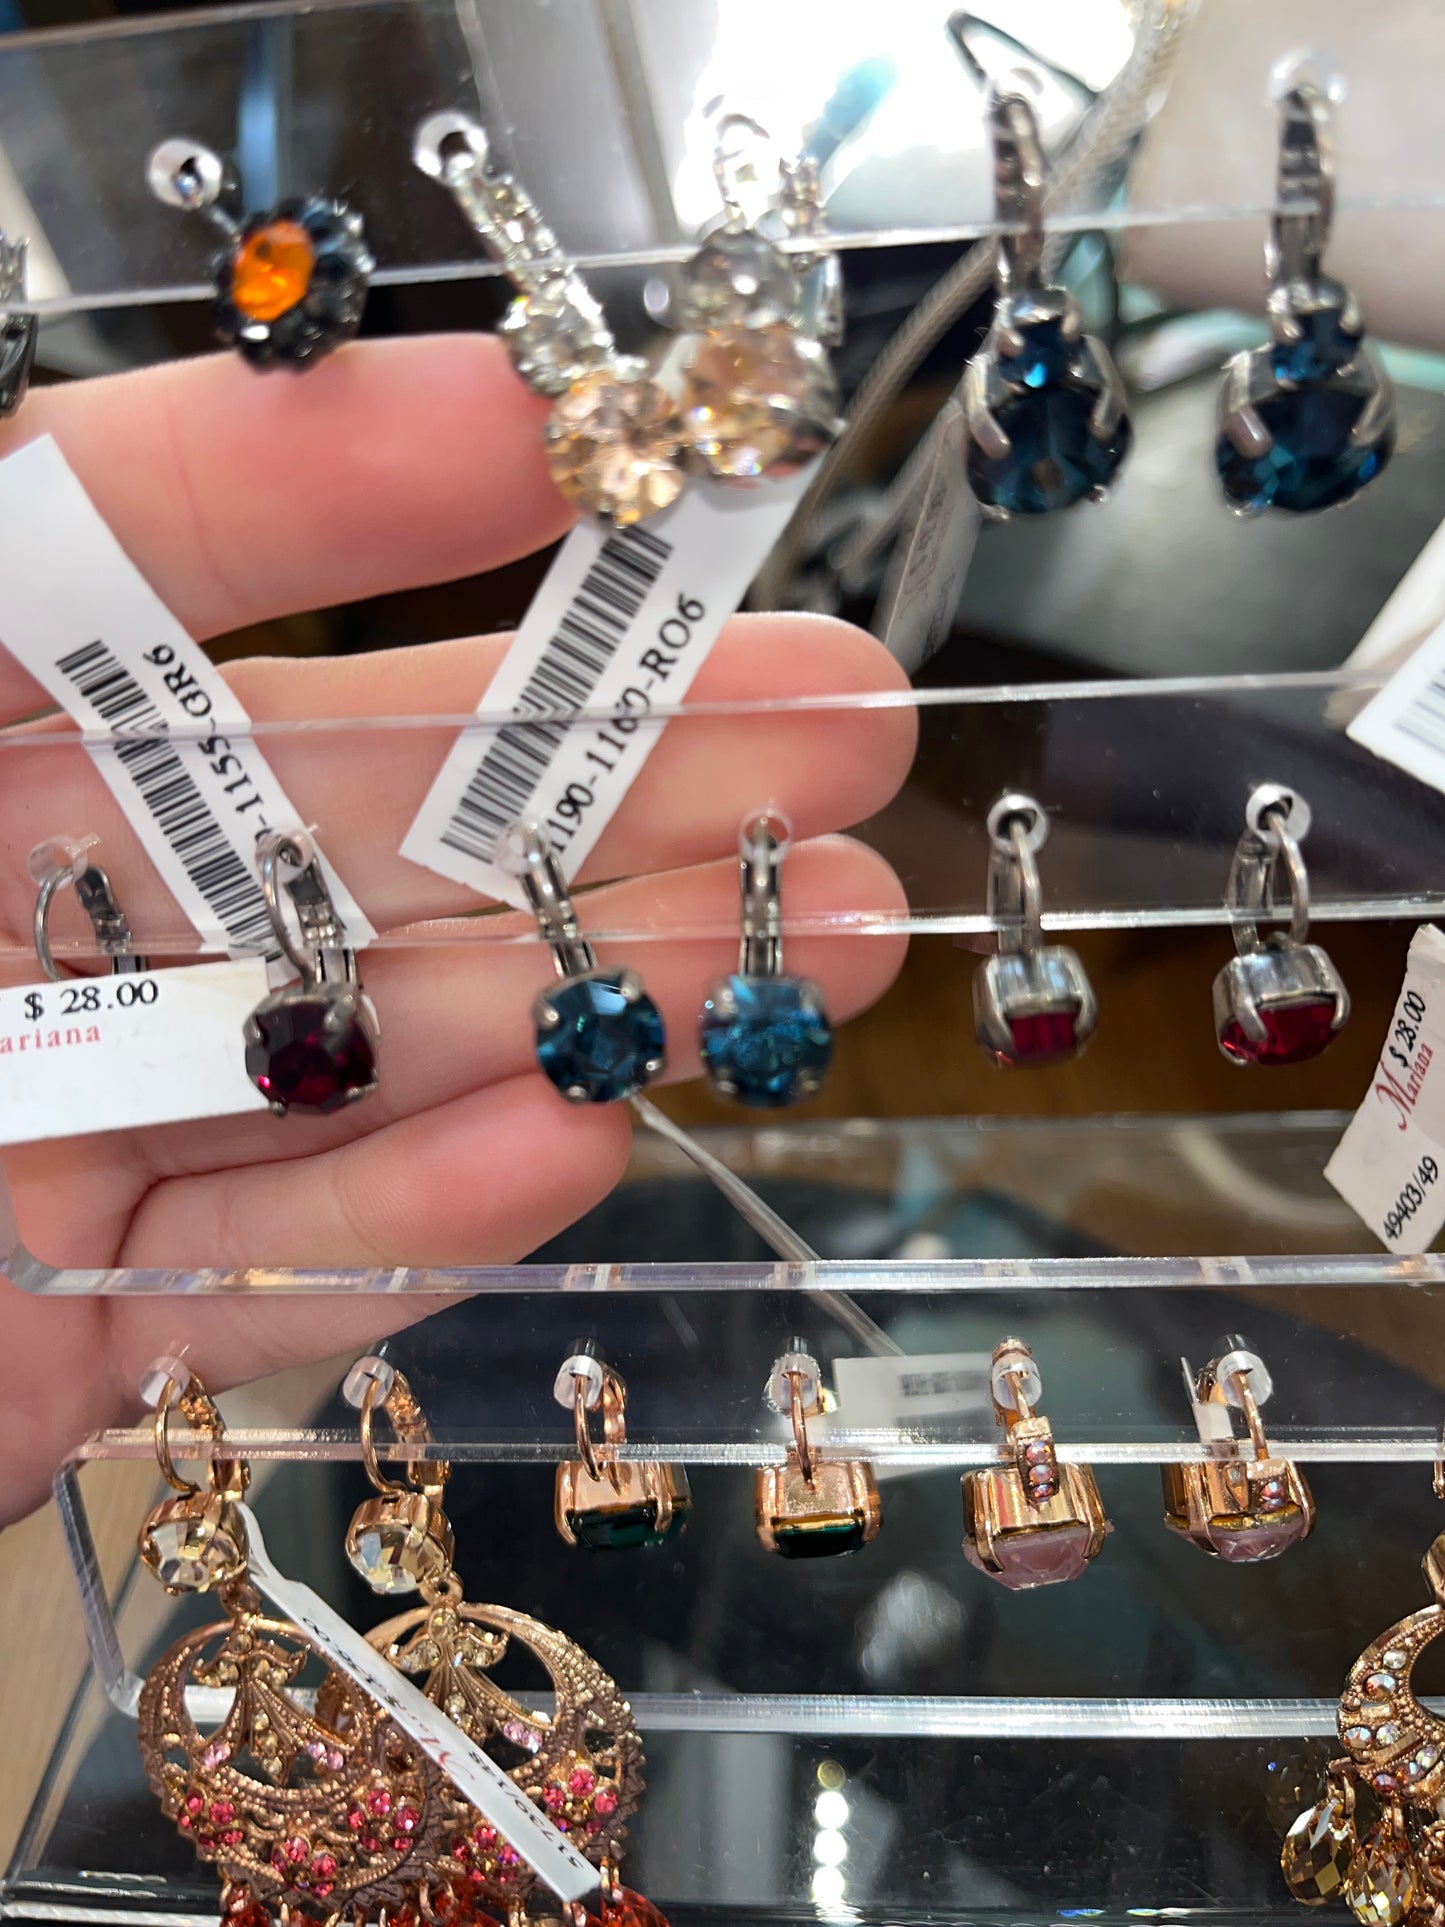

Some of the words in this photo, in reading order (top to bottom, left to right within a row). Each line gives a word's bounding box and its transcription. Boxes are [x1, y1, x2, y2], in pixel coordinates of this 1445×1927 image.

[142, 644, 274, 842] -1155-GR6
[24, 992, 45, 1021] $
[60, 980, 159, 1015] 28.00
[1394, 990, 1427, 1053] 28.00
[0, 1026, 101, 1055] ariana
[1388, 1045, 1409, 1069] $
[1375, 1043, 1435, 1131] Mariana
[1382, 1154, 1439, 1240] 49403/49
